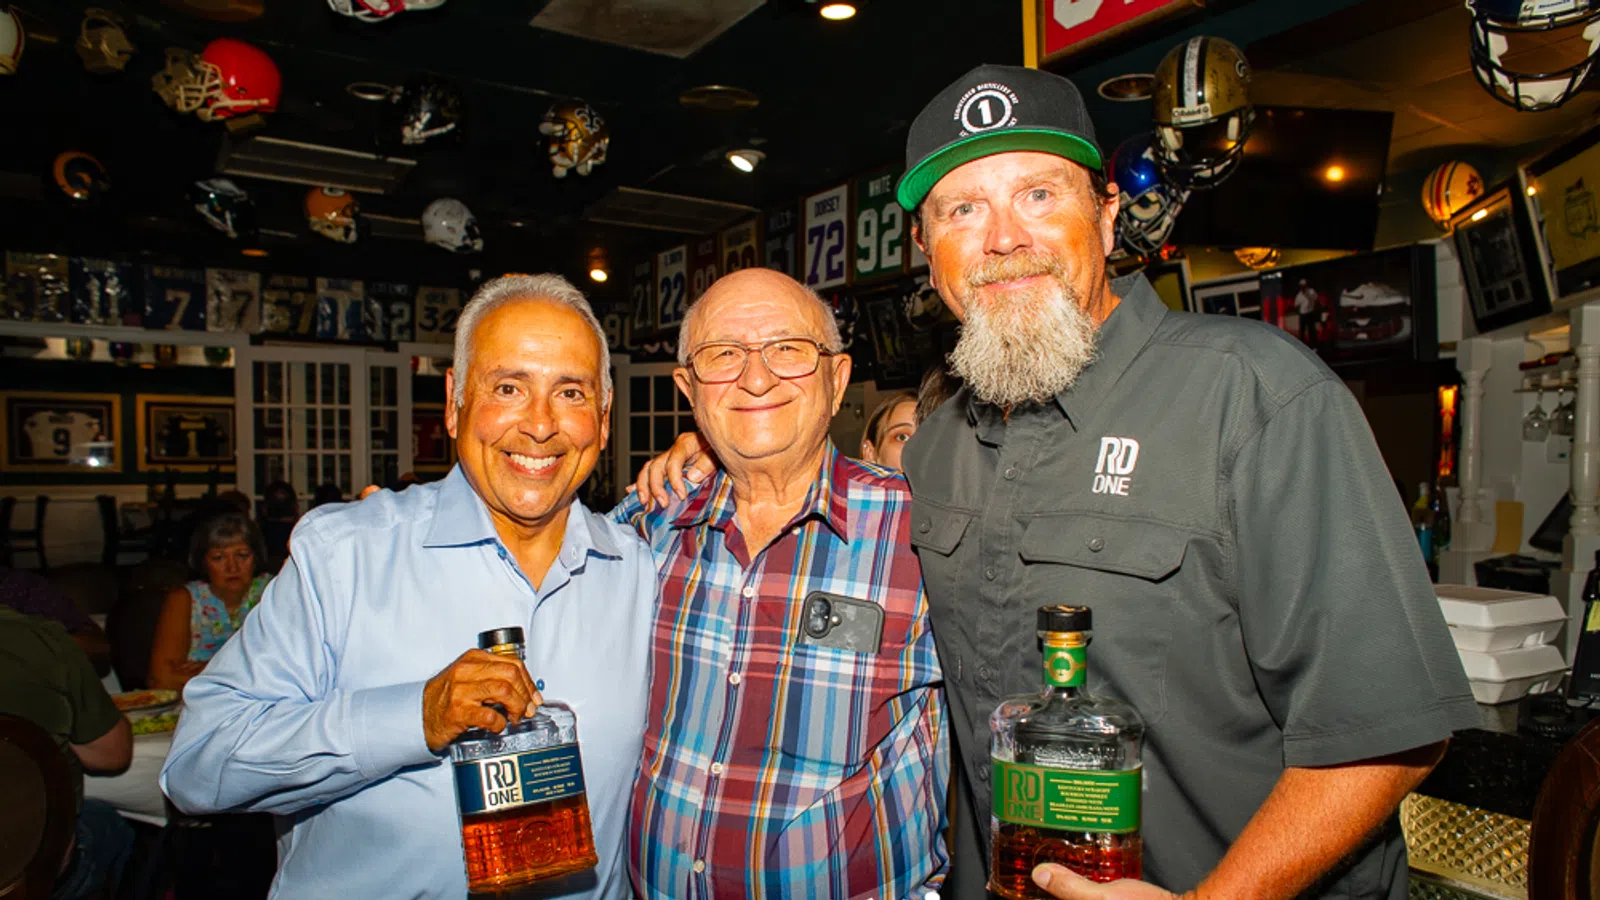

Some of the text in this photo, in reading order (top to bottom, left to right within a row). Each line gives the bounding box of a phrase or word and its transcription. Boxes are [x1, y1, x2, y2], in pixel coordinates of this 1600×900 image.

[977, 98, 993, 125] 1
[814, 195, 840, 218] DORSEY
[856, 201, 904, 273] 92
[807, 219, 844, 285] 72
[164, 288, 192, 330] 7
[660, 272, 686, 325] 22
[419, 306, 459, 334] 32
[53, 427, 70, 455] 9
[1095, 436, 1141, 475] RD
[1092, 474, 1131, 496] ONE
[485, 759, 517, 790] RD
[1007, 768, 1041, 803] RD
[488, 787, 520, 806] ONE
[1007, 801, 1041, 821] ONE
